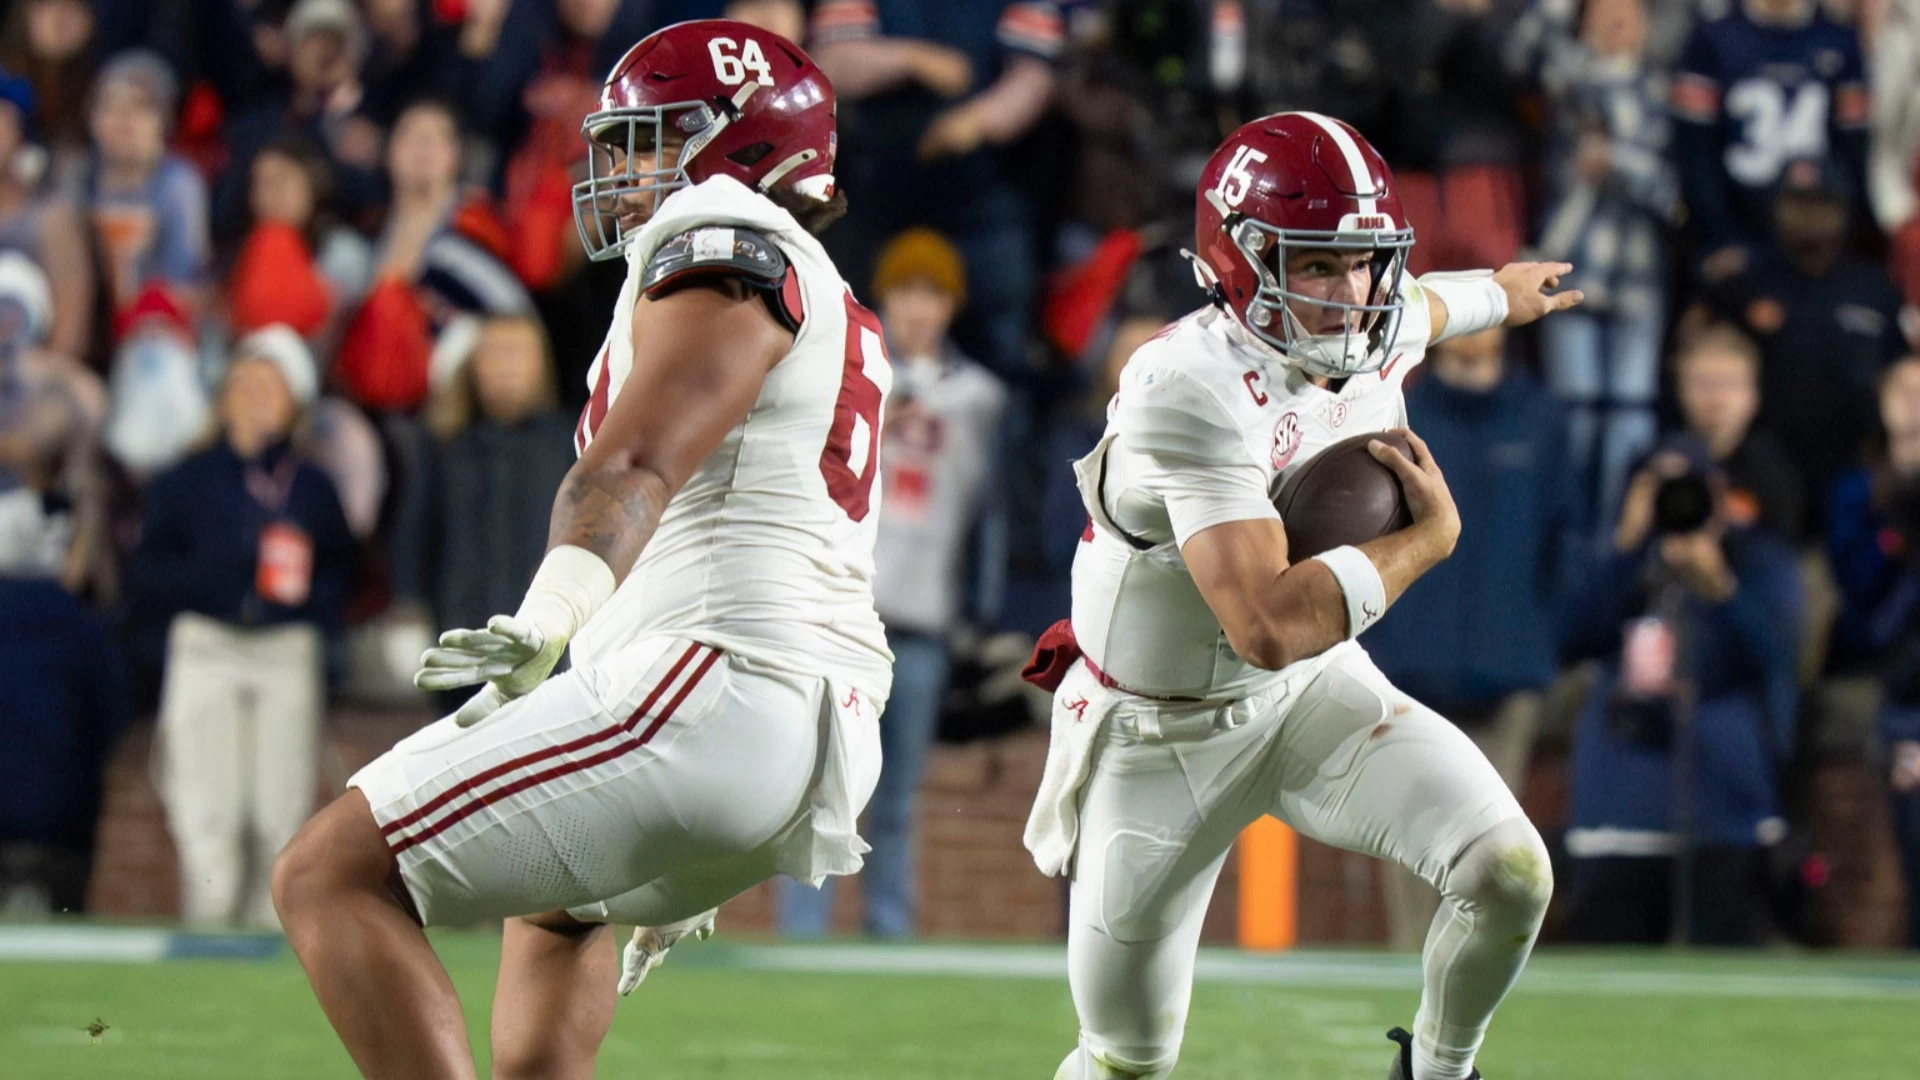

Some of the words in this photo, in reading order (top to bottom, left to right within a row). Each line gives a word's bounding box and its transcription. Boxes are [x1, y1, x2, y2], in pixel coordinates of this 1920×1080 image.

[707, 37, 775, 86] 64
[1724, 78, 1830, 188] 34
[1215, 144, 1268, 208] 15
[1243, 370, 1268, 407] C
